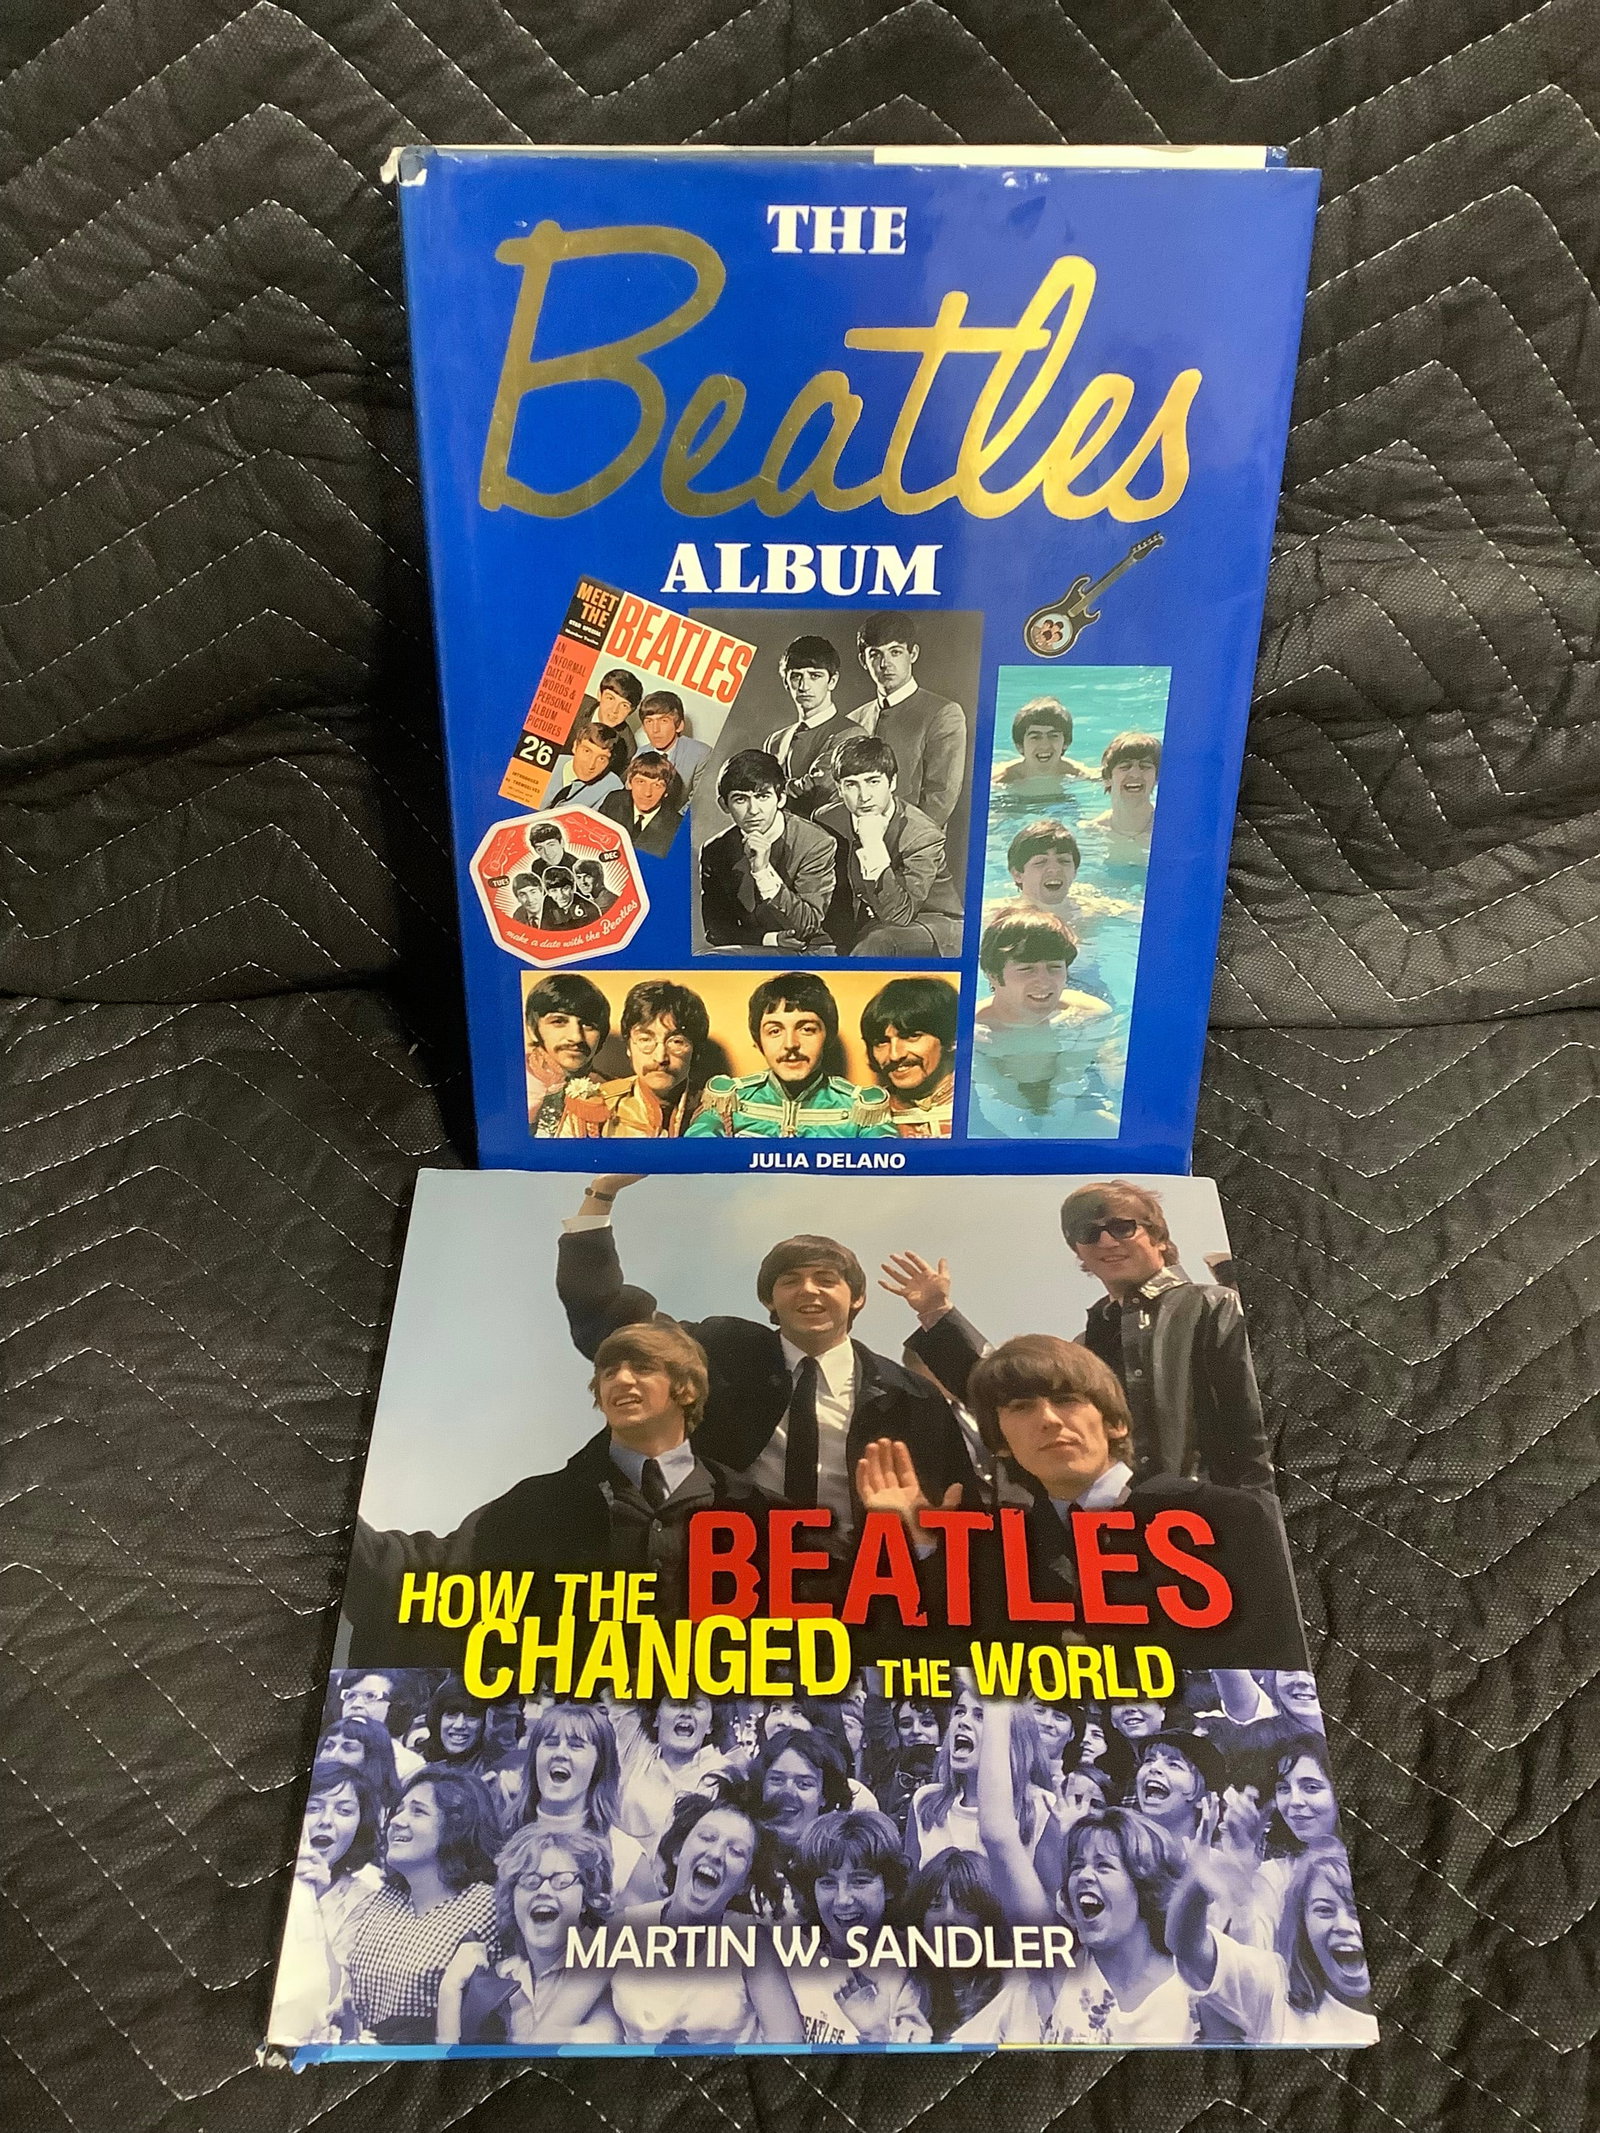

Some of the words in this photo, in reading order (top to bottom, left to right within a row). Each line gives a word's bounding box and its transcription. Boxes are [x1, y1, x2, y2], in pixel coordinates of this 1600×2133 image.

[766, 205, 908, 256] THE
[479, 219, 1203, 522] Beatles
[660, 543, 943, 598] ALBUM
[576, 581, 620, 612] MEET
[581, 602, 610, 629] THE
[555, 641, 567, 654] AN
[606, 595, 755, 704] BEATLES
[546, 665, 563, 682] DATE
[564, 673, 574, 685] IN
[551, 653, 586, 678] INFORMAL
[542, 678, 569, 698] WORDS
[568, 690, 576, 700] &
[531, 703, 558, 721] ALBUM
[536, 690, 572, 714] PERSONAL
[526, 715, 562, 738] PICTURES
[603, 852, 619, 862] DEC
[491, 879, 510, 888] TUES
[574, 905, 584, 917] 6
[505, 930, 529, 944] make
[540, 938, 562, 948] date
[563, 936, 584, 948] with
[585, 931, 601, 942] the
[600, 900, 638, 935] Beatles
[749, 1152, 810, 1169] JULIA
[816, 1152, 906, 1169] DELANO
[397, 1570, 529, 1629] HOW
[554, 1571, 659, 1625] THE
[687, 1509, 1235, 1628] BEATLES
[463, 1615, 853, 1701] CHANGED
[876, 1659, 951, 1696] THE
[969, 1640, 1176, 1701] WORLD
[564, 1925, 757, 1970] MARTIN
[772, 1926, 830, 1969] W.
[845, 1925, 1077, 1970] SANDLER
